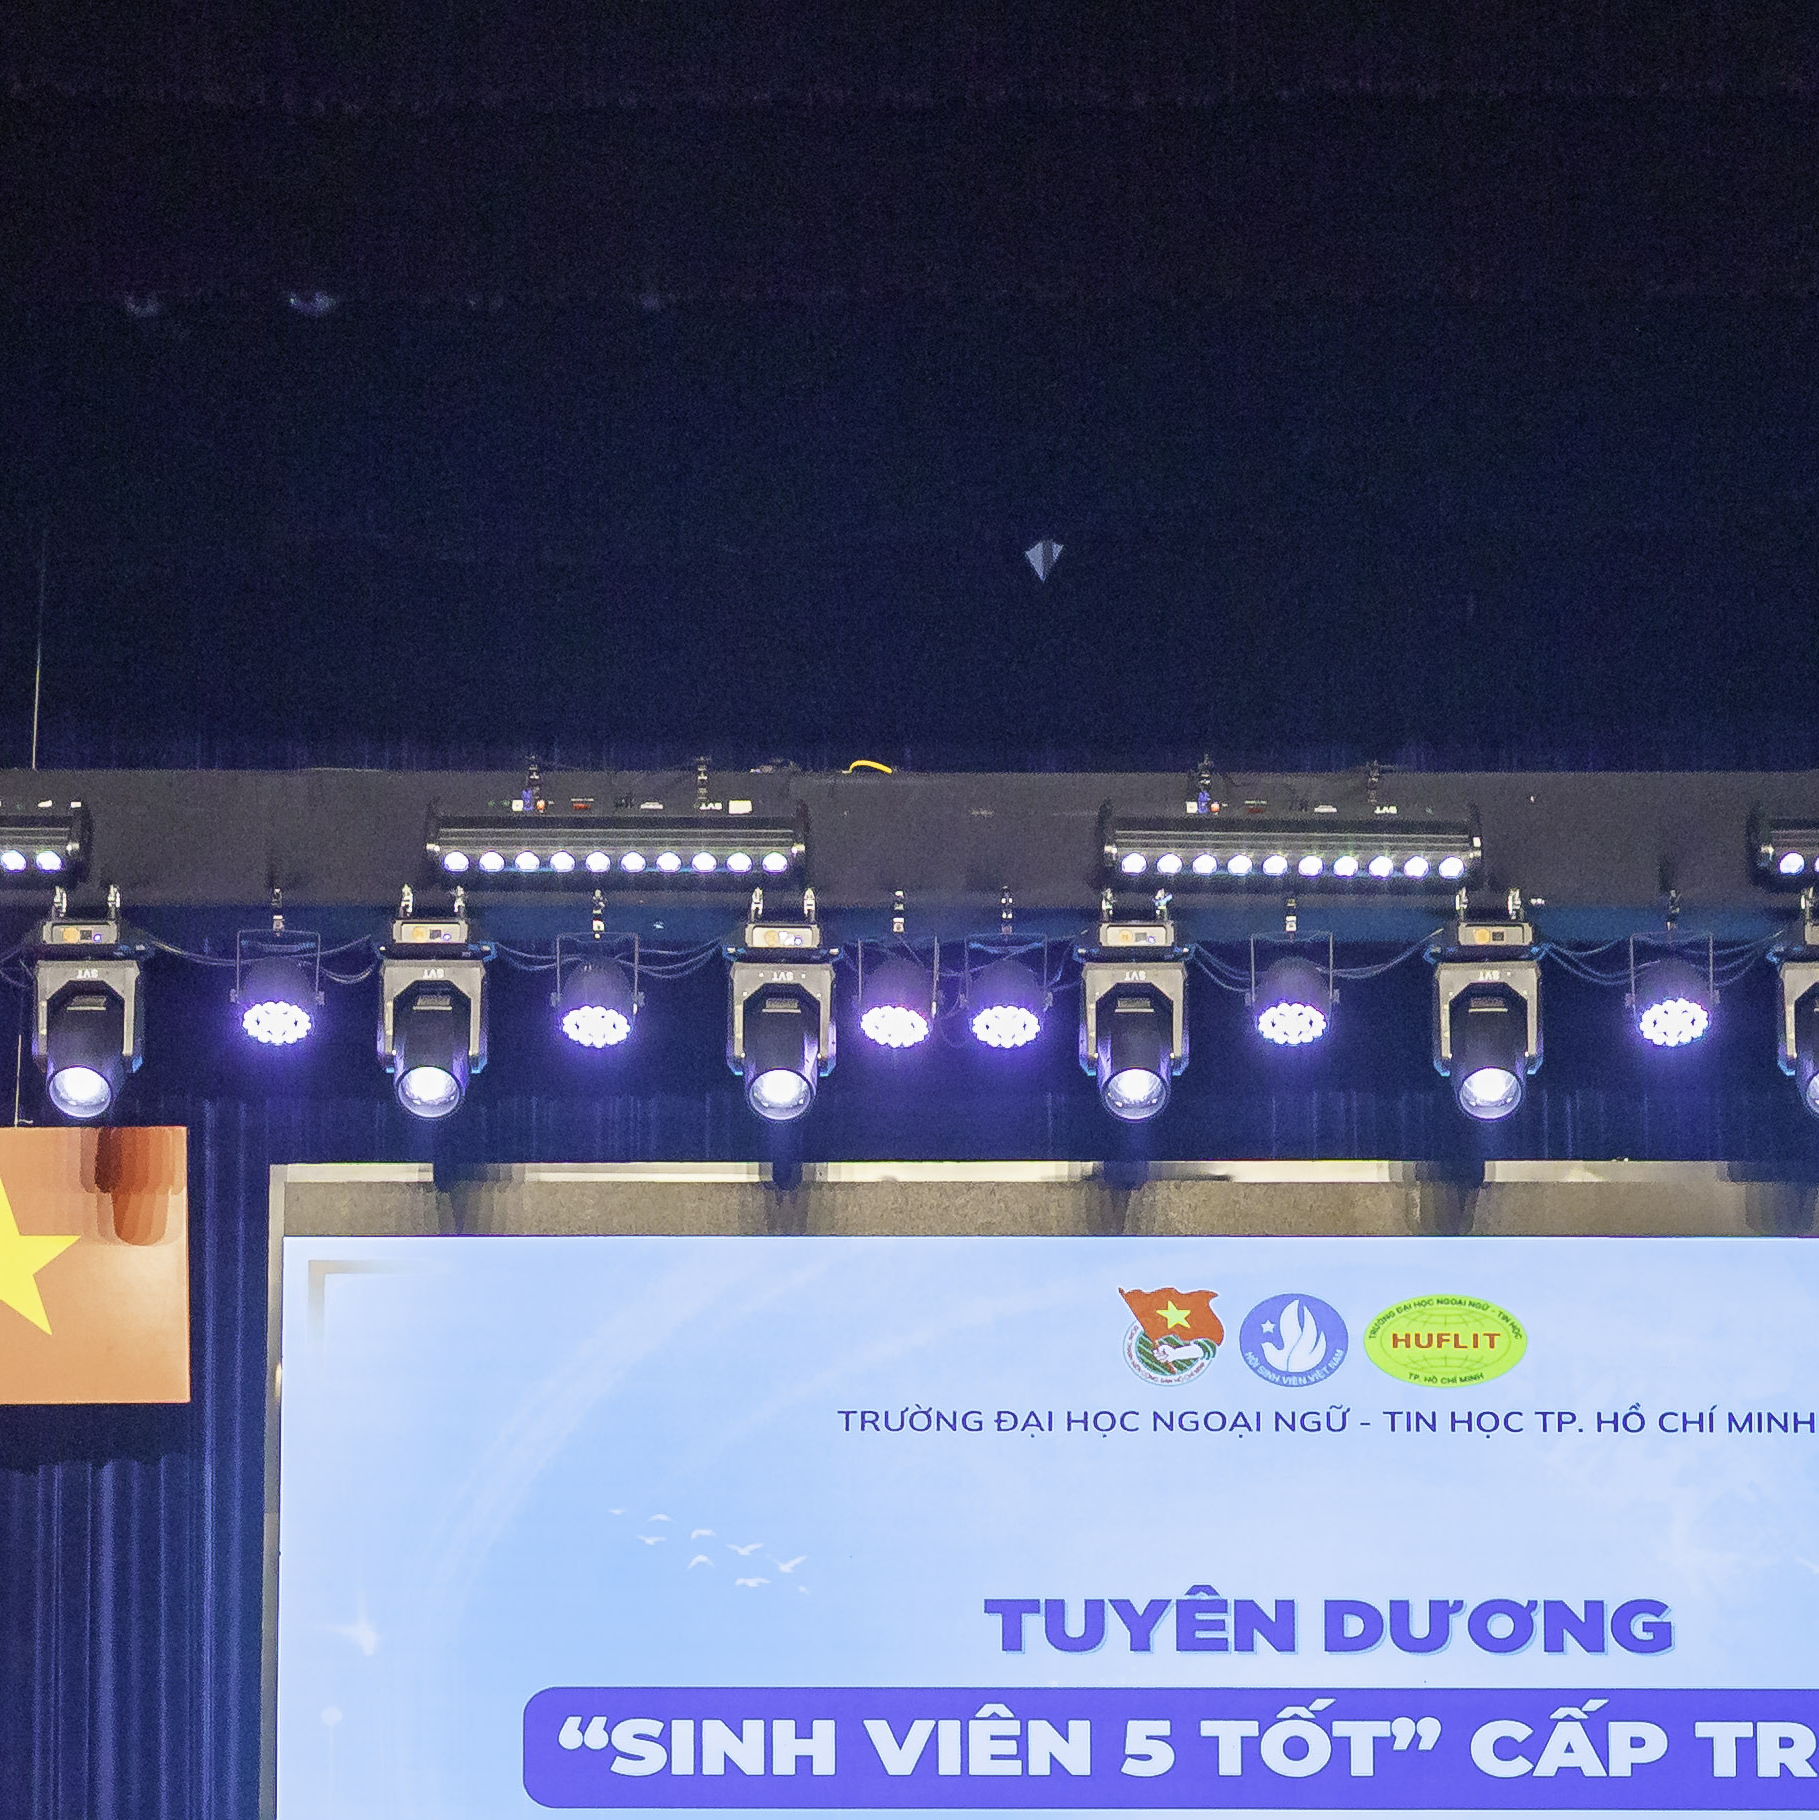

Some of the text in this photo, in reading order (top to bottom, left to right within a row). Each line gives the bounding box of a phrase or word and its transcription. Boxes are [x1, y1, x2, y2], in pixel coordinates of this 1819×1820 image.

[1392, 1333, 1501, 1349] HUFLIT
[837, 1403, 983, 1432] TRƯỜNG
[994, 1410, 1053, 1438] ĐẠI
[1067, 1410, 1140, 1438] HỌC
[1153, 1410, 1261, 1438] NGOẠI
[1274, 1404, 1351, 1433] NGỮ
[1383, 1410, 1437, 1433] TIN
[1451, 1410, 1524, 1439] HỌC
[1535, 1411, 1584, 1433] TP.
[1596, 1402, 1646, 1433] HỒ
[1658, 1404, 1718, 1433] CHÍ
[1728, 1411, 1816, 1434] MINH
[984, 1585, 1675, 1654] TUYÊN DƯƠNG
[558, 1716, 836, 1777] “SINH
[864, 1703, 1092, 1776] VIÊN
[1120, 1719, 1175, 1777] 5
[1200, 1698, 1442, 1778] TỐT”
[1470, 1699, 1668, 1778] CẤP
